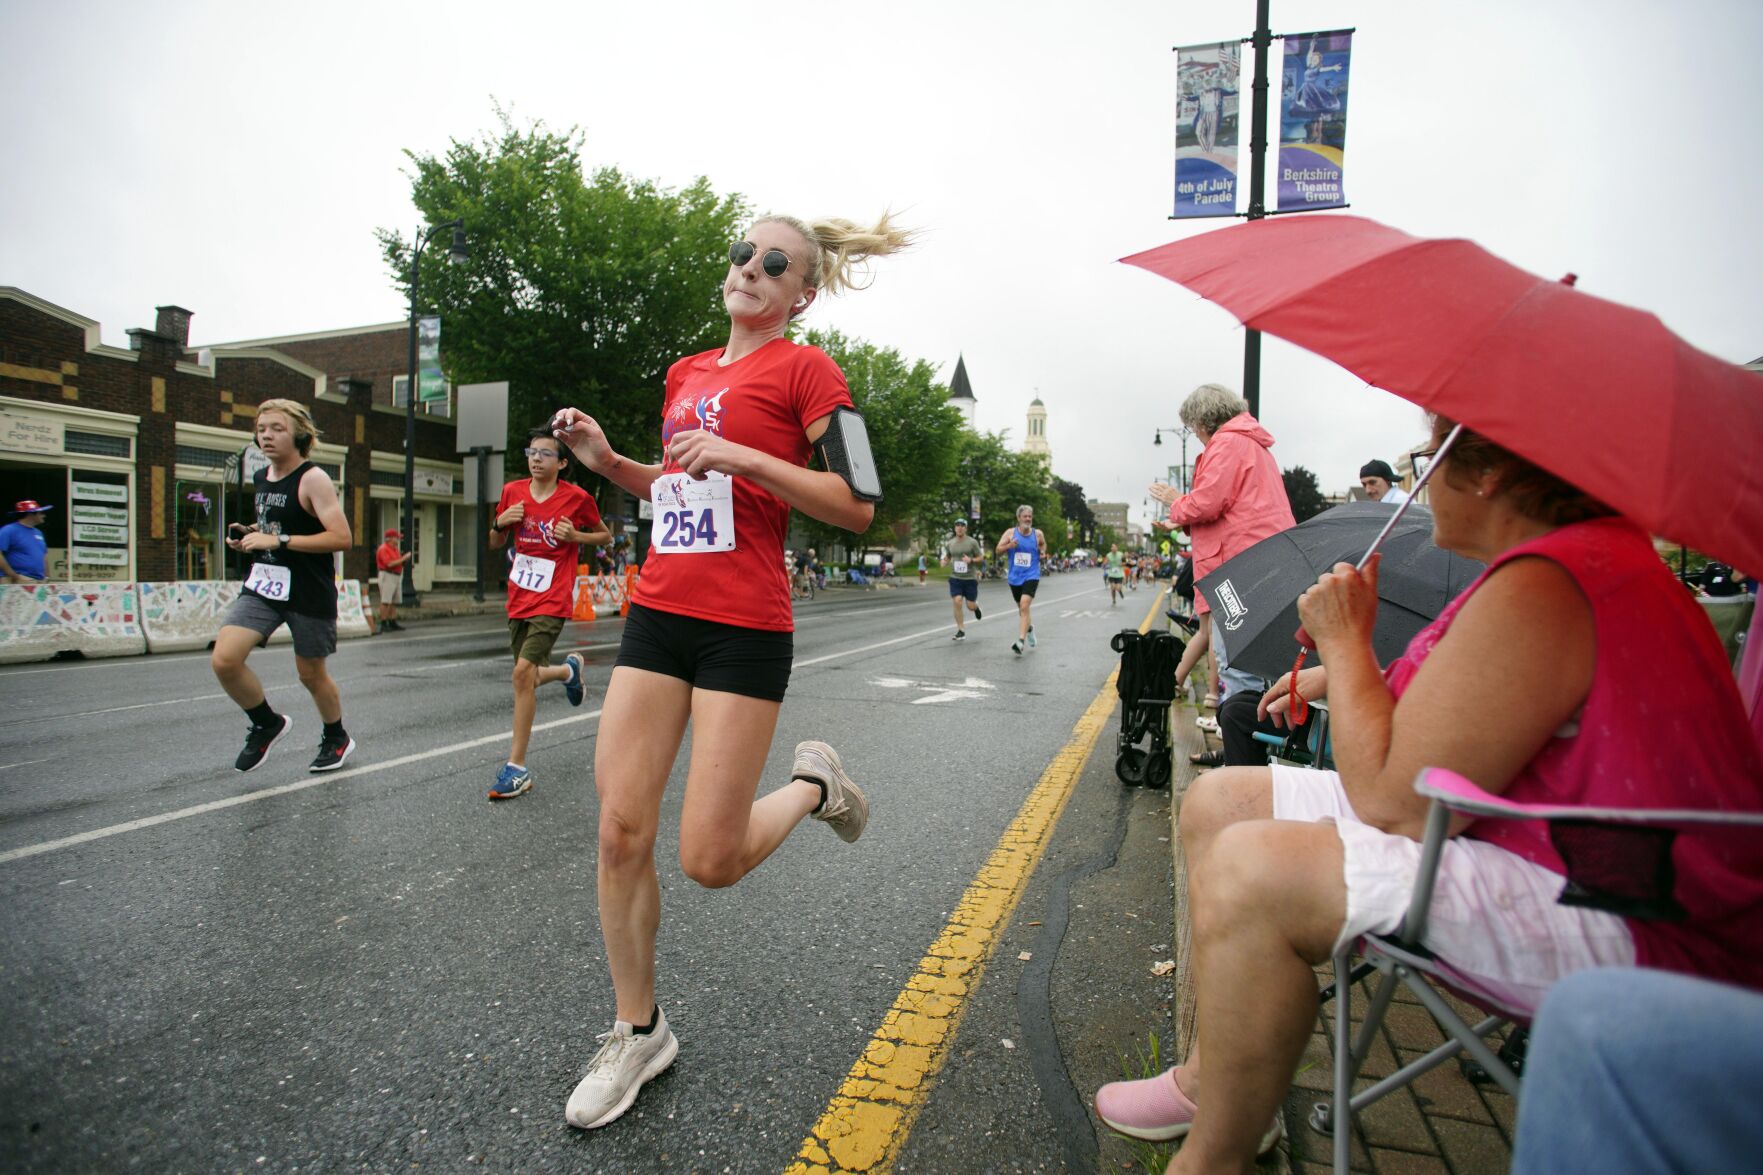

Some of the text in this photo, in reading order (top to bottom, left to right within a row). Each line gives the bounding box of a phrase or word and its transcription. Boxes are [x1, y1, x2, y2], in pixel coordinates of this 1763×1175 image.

[1283, 168, 1338, 181] Berkshire
[1178, 178, 1233, 194] 4th of July
[1295, 181, 1338, 192] Theatre
[1194, 192, 1232, 205] Parade
[1305, 190, 1340, 203] Group
[660, 508, 717, 547] 254
[517, 569, 545, 588] 117
[254, 578, 284, 597] 143
